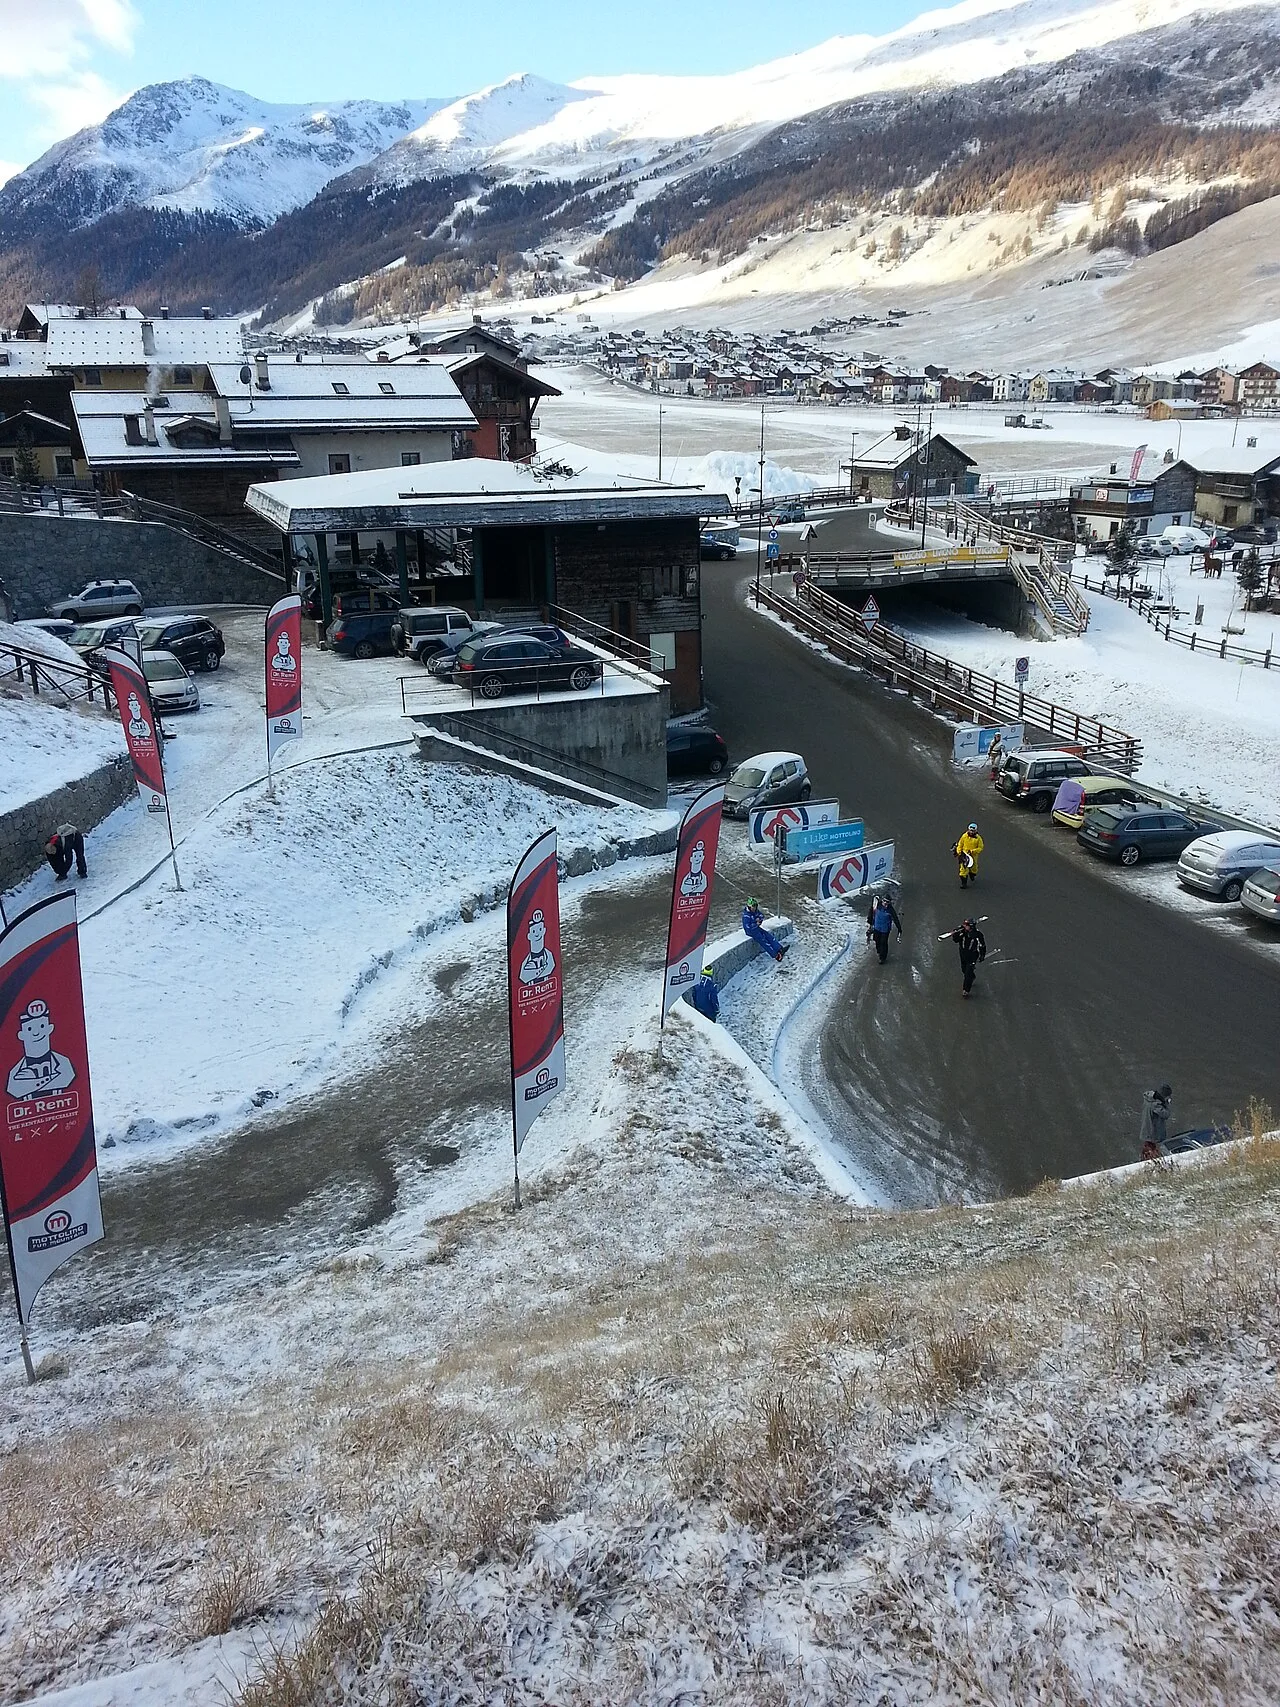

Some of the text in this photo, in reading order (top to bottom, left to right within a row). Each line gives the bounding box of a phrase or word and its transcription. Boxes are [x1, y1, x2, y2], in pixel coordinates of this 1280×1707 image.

[968, 547, 1004, 555] LIVIGNO
[522, 990, 534, 998] Dr.
[13, 1097, 72, 1118] Dr. Rent
[21, 1118, 45, 1128] RENTAL
[45, 1111, 79, 1122] SPECIALIST
[31, 1225, 84, 1244] MOTTOLINO
[49, 1230, 85, 1246] MOUNTAIN
